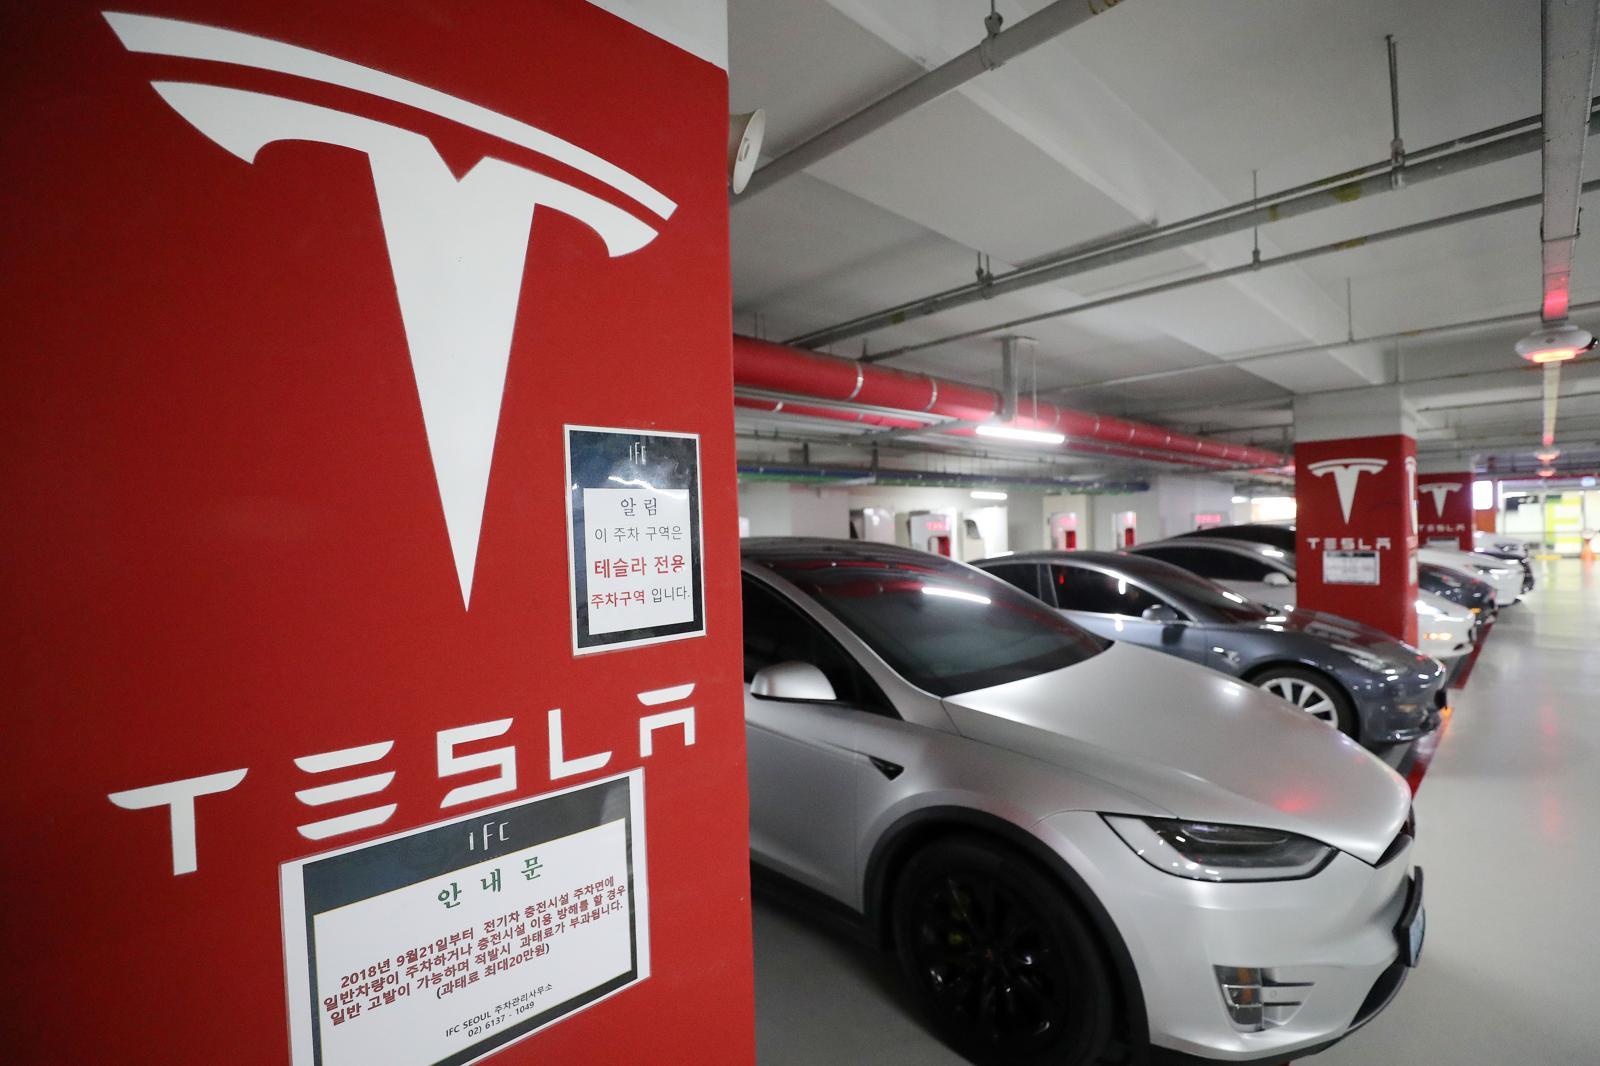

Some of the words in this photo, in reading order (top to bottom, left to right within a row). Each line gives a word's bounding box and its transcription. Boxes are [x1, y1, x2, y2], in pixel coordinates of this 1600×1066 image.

[629, 441, 647, 465] IFC
[595, 527, 607, 543] 이
[613, 527, 639, 542] 주차
[645, 525, 683, 541] 구역은
[1307, 537, 1391, 550] TESLA
[594, 556, 647, 579] 테슬라
[654, 554, 685, 574] 전용
[591, 589, 646, 609] 주차구역
[651, 585, 691, 603] 입니다.
[107, 683, 696, 876] TESLA
[468, 821, 510, 852] IFC
[323, 971, 400, 1012] 일반차량이
[405, 943, 473, 979] 주차하거나
[477, 922, 526, 951] 충전시설
[530, 913, 553, 930] 이용
[556, 899, 590, 921] 방해를
[593, 894, 604, 907] 할
[607, 884, 626, 901] 경우
[340, 958, 391, 989] 2018년
[396, 927, 475, 967] 9월21일부터
[483, 911, 520, 934] 전기차
[524, 892, 570, 918] 충전시설
[573, 875, 615, 901] 주차면에
[330, 1003, 362, 1026] 일반
[367, 982, 411, 1012] 고발이
[416, 959, 470, 990] 가능하며
[474, 942, 512, 966] 적발시
[519, 923, 566, 949] 과태료가
[569, 903, 624, 929] 부과됩니다.
[436, 971, 480, 1000] (과태료
[484, 943, 551, 978] 최대20만원)
[445, 1024, 461, 1037] IFC
[462, 1011, 493, 1030] SEOUL
[494, 983, 553, 1015] 주차관리사무소
[467, 1025, 483, 1039] 02)
[485, 1013, 507, 1030] 6137
[514, 1000, 536, 1016] 1049
